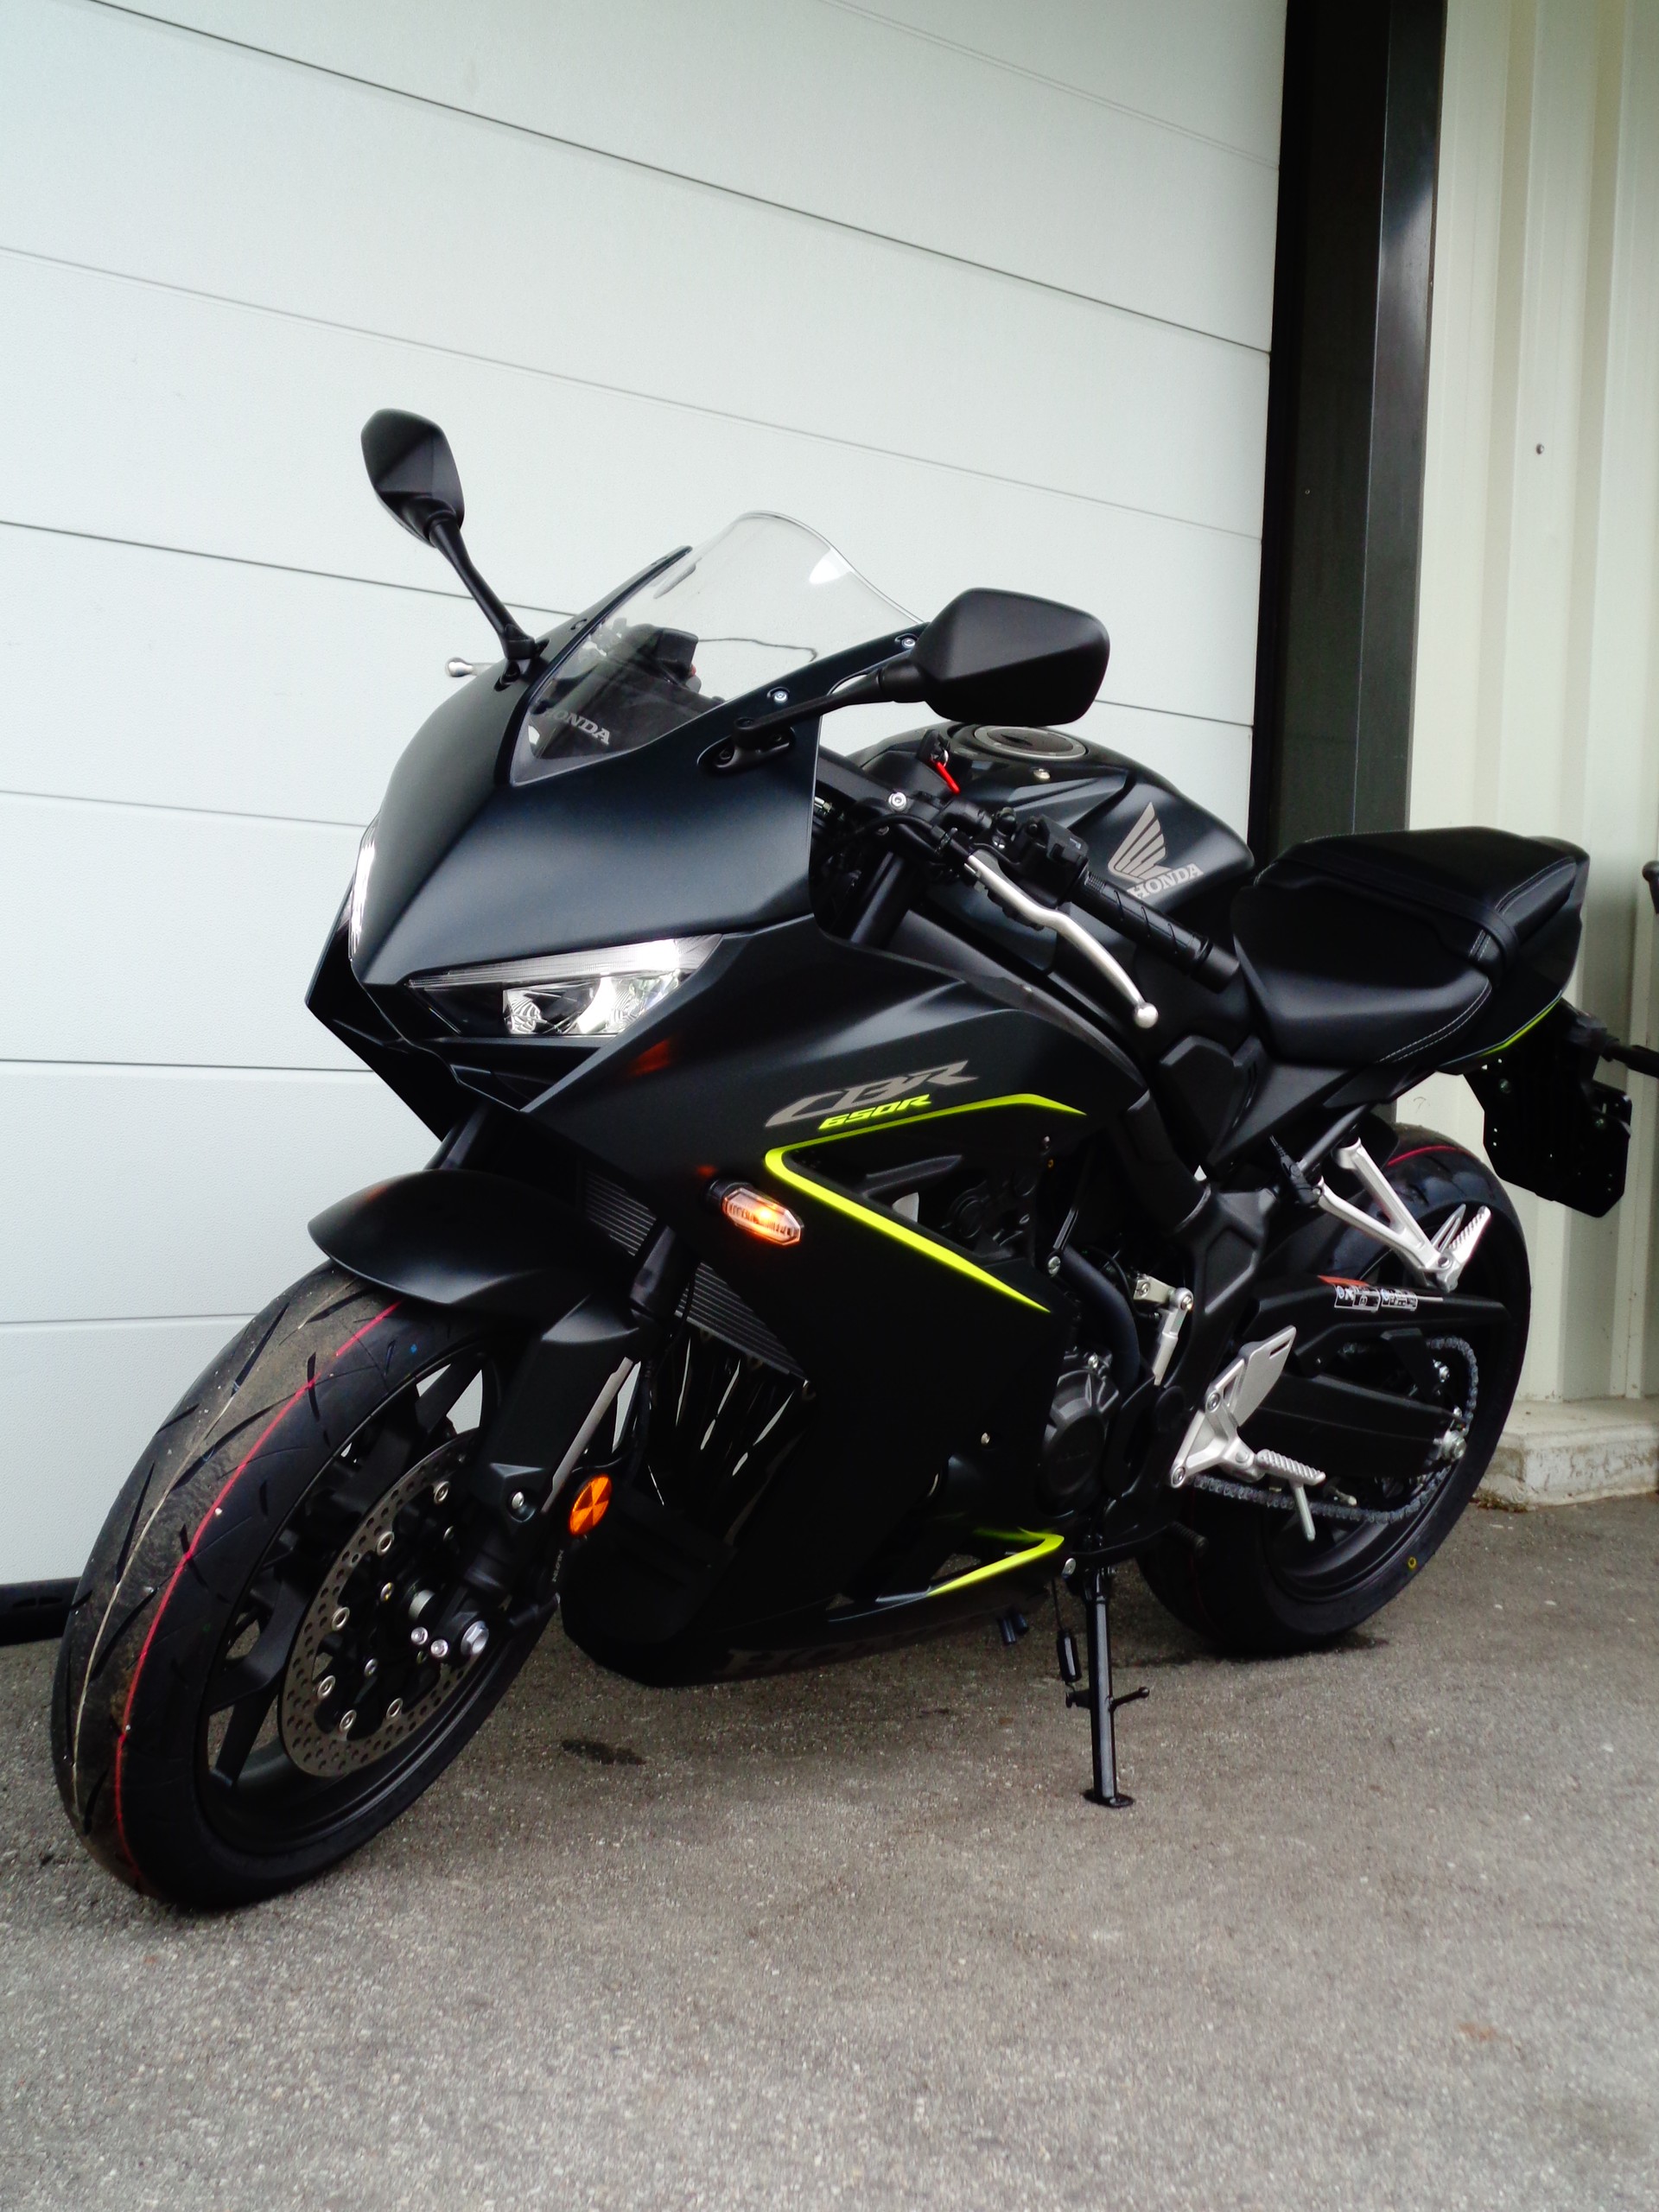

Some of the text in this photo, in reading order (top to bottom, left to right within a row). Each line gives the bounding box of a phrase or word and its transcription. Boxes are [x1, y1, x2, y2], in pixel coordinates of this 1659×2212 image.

[1127, 863, 1204, 899] HONDA
[766, 1059, 978, 1127] CBR
[818, 1093, 931, 1129] 650R
